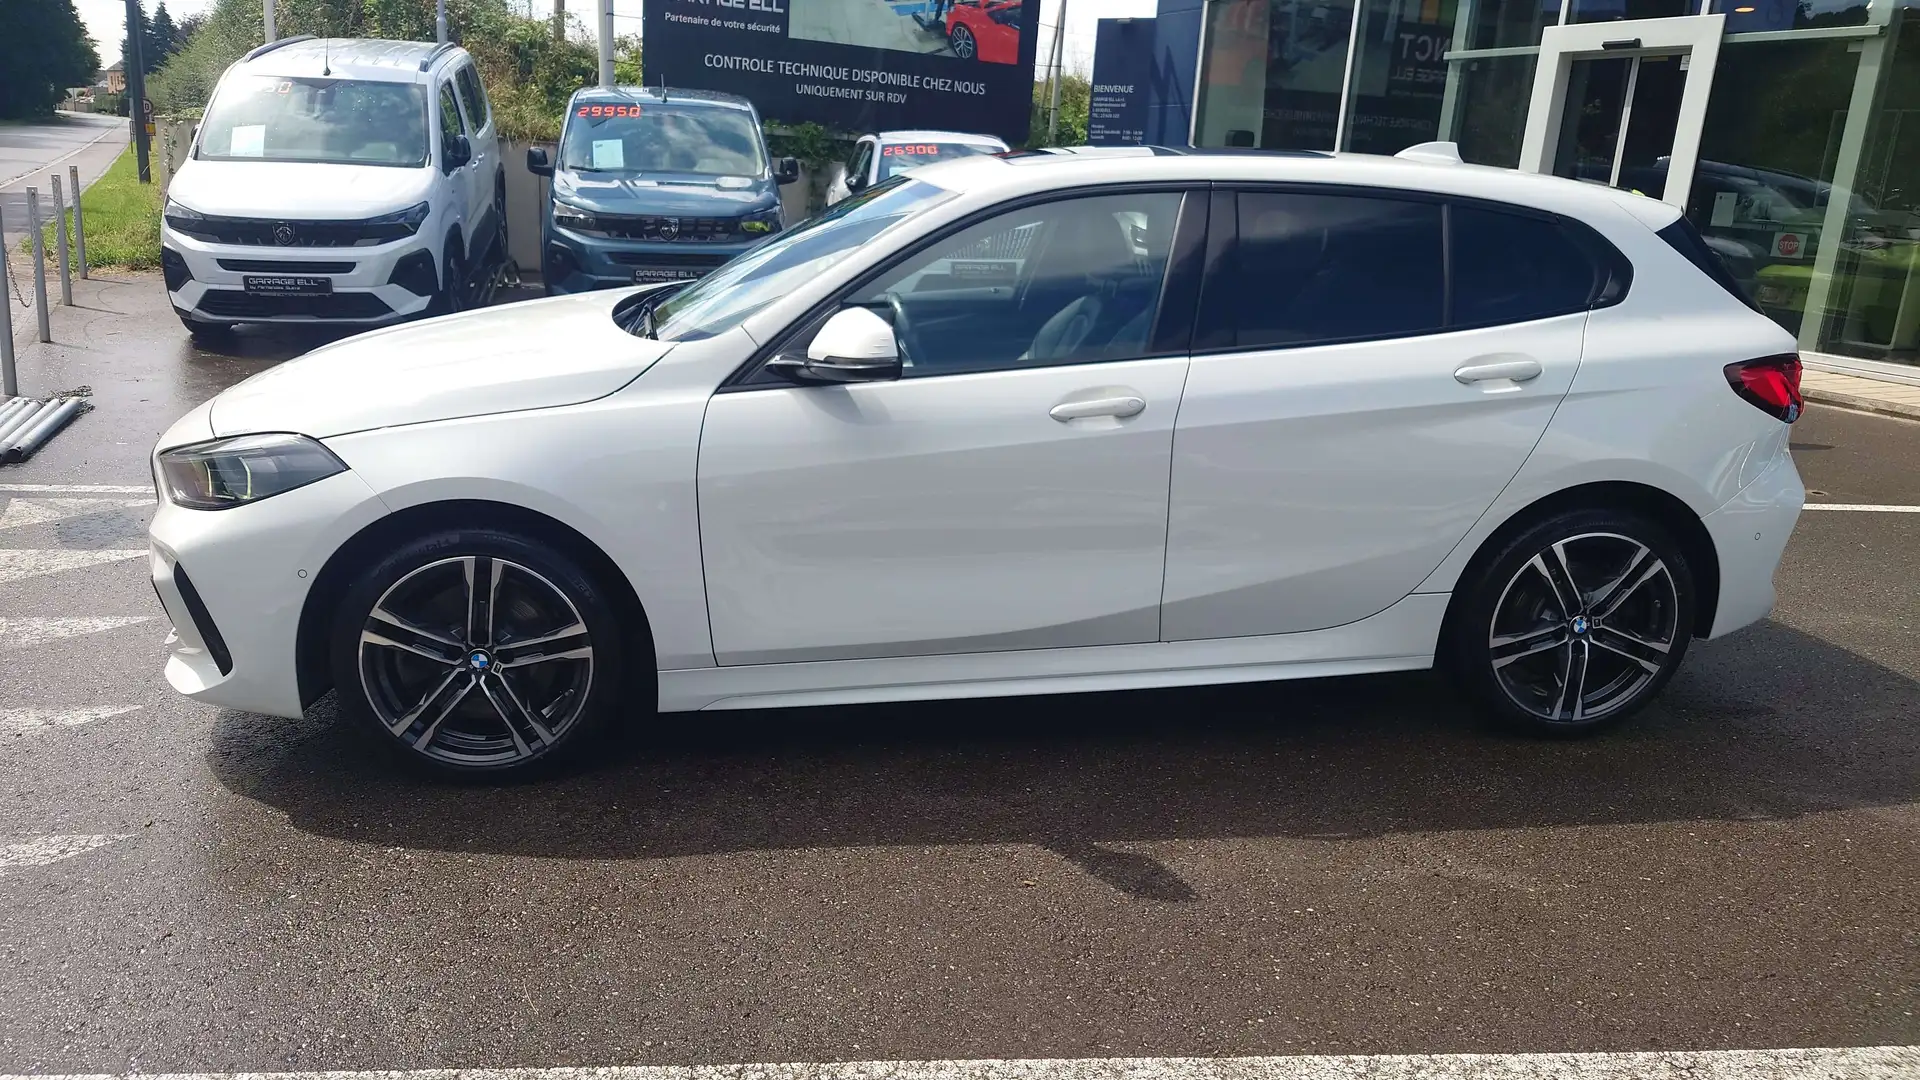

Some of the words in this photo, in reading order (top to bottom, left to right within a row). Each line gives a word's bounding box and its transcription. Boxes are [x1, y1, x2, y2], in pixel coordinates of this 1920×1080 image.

[665, 12, 709, 26] Partenaire
[711, 18, 722, 27] de
[724, 20, 745, 29] votre
[747, 22, 780, 34] sécurité
[704, 54, 774, 73] CONTROLE
[777, 61, 849, 80] TECHNIQUE
[852, 69, 920, 88] DISPONIBLE
[922, 77, 952, 92] CHEZ
[954, 81, 986, 95] NOUS
[796, 84, 864, 99] UNIQUEMENT
[865, 90, 885, 102] SUR
[887, 92, 907, 104] RDV
[1094, 84, 1134, 93] BIENVENUE
[577, 105, 641, 118] 29950
[883, 145, 938, 156] 26900
[1779, 240, 1799, 250] STOP
[636, 270, 677, 278] GARAGE
[248, 277, 295, 286] GARAGE
